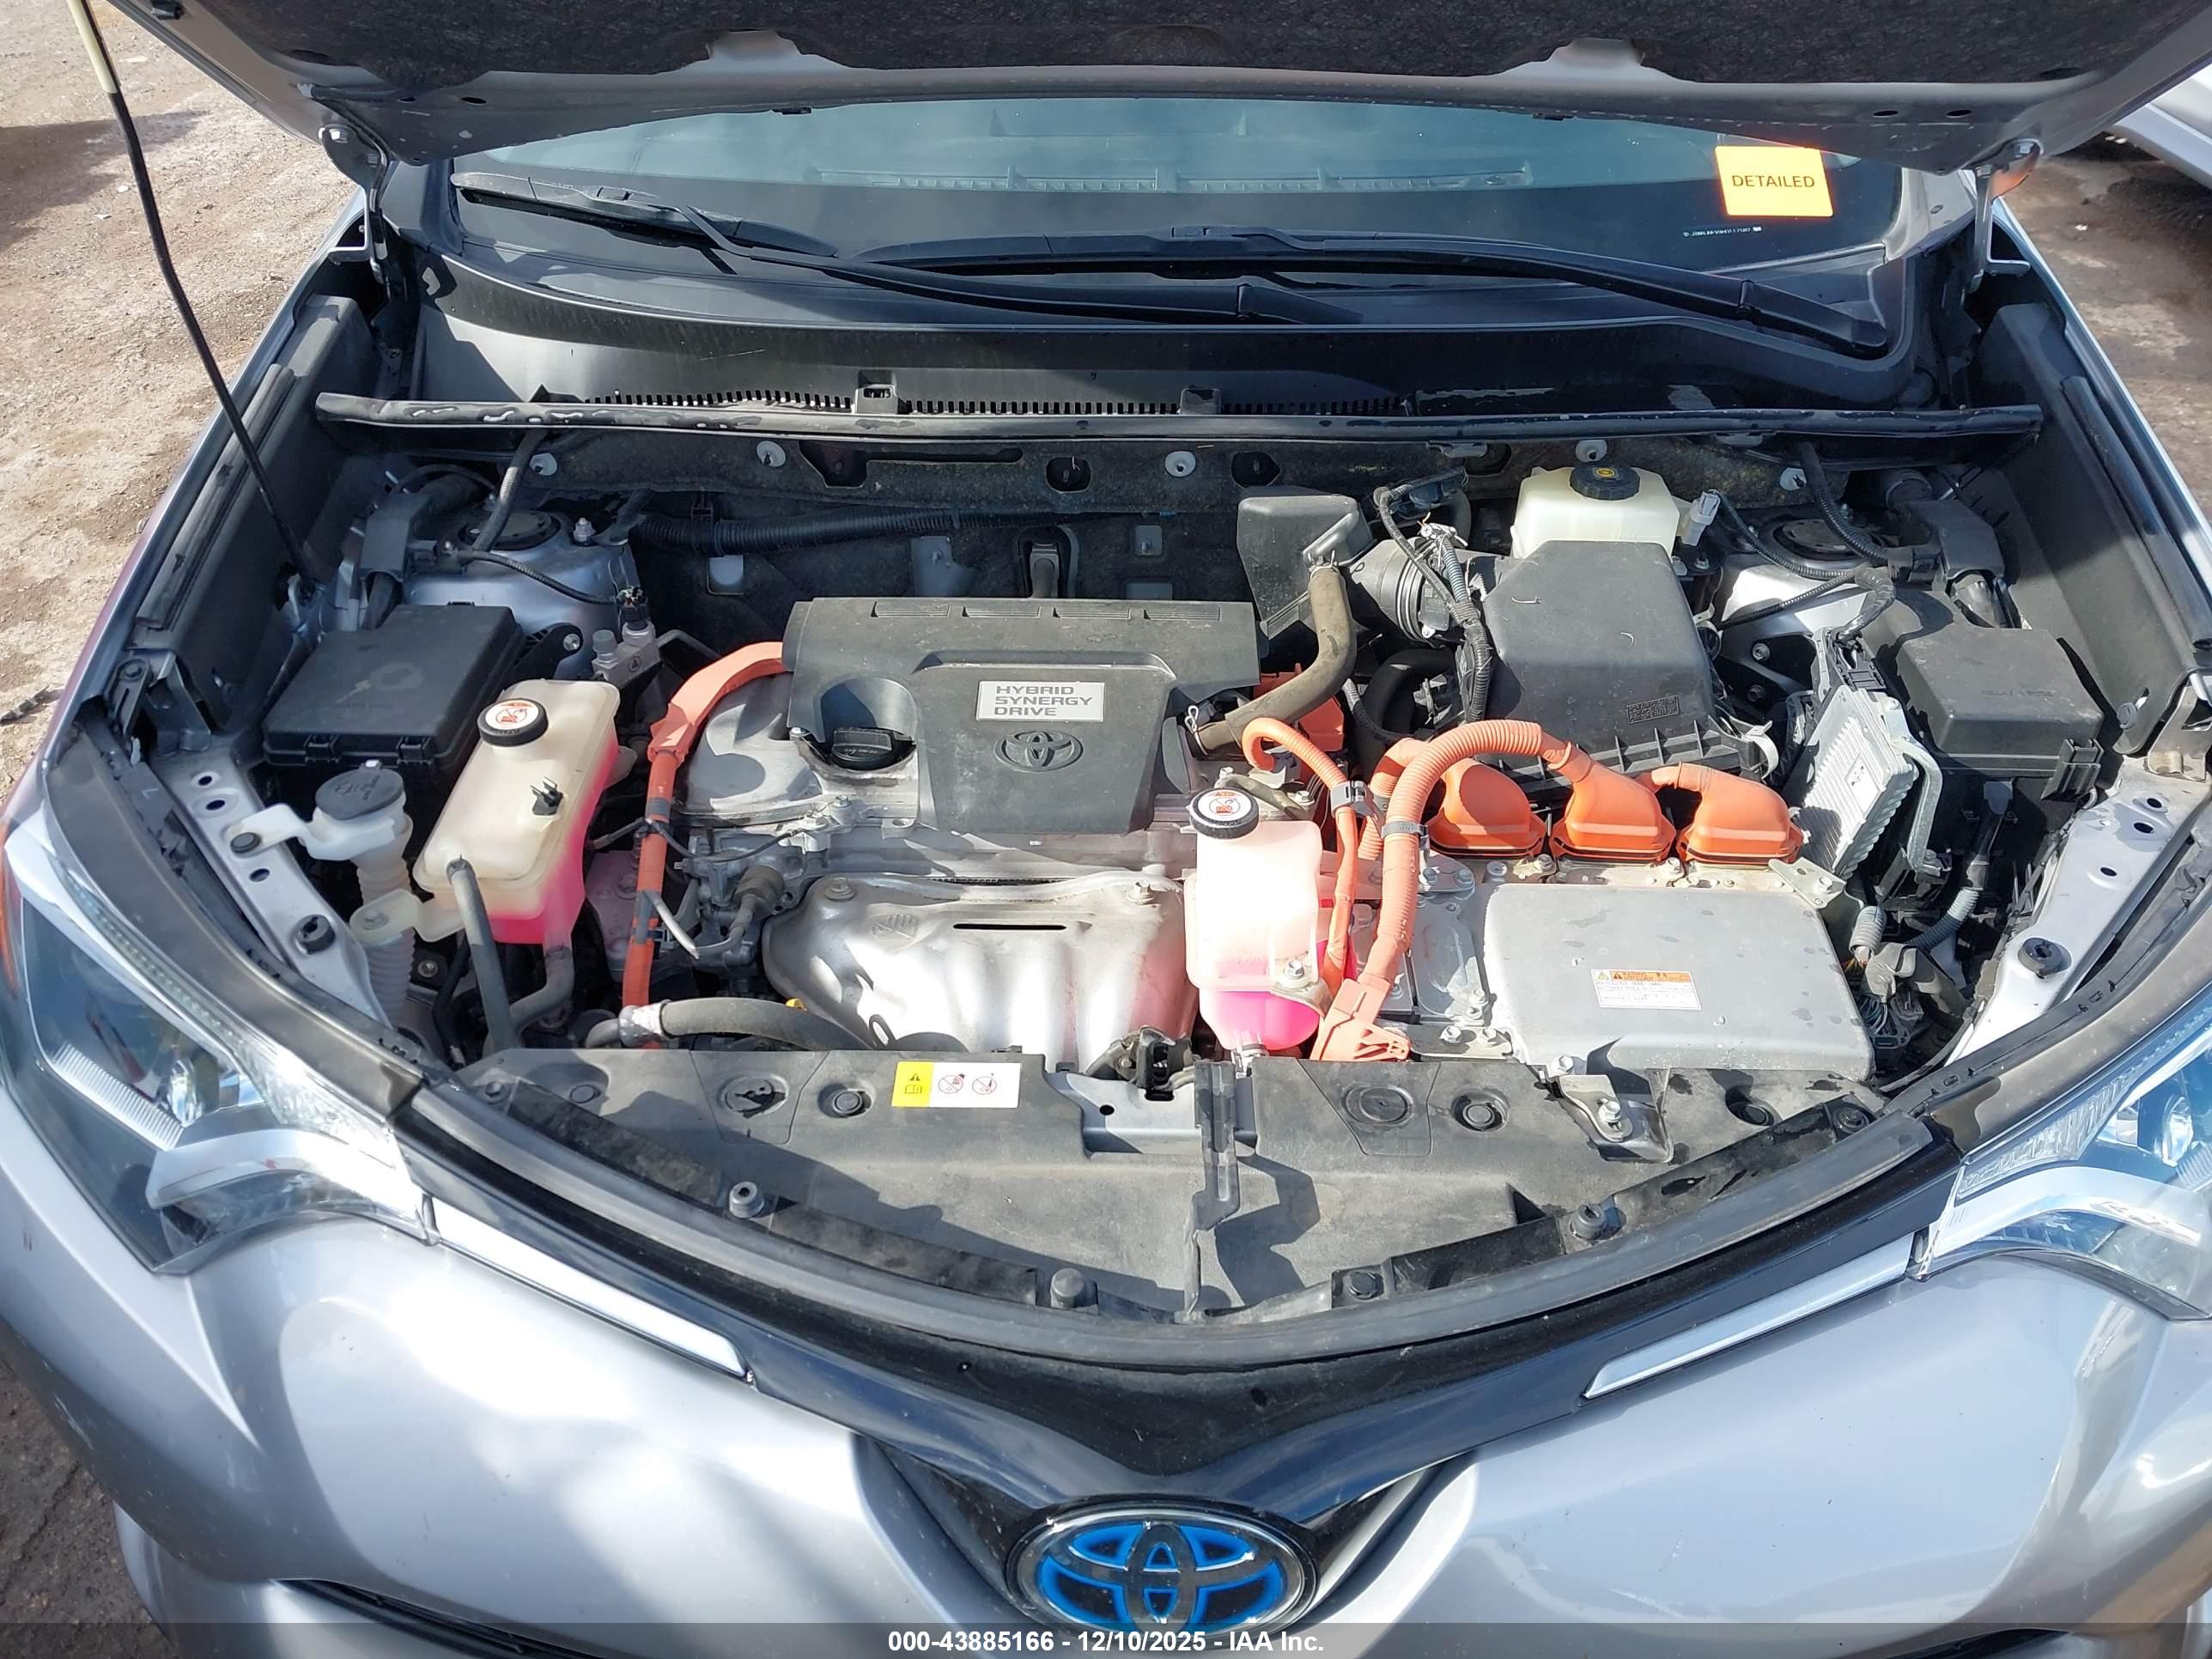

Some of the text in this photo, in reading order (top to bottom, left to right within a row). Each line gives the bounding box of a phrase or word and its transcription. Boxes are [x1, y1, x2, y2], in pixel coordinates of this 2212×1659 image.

[1731, 174, 1815, 188] DETAILED
[996, 685, 1074, 695] HYBRID
[994, 696, 1093, 706] SYNERGY
[994, 707, 1057, 716] DRIVE
